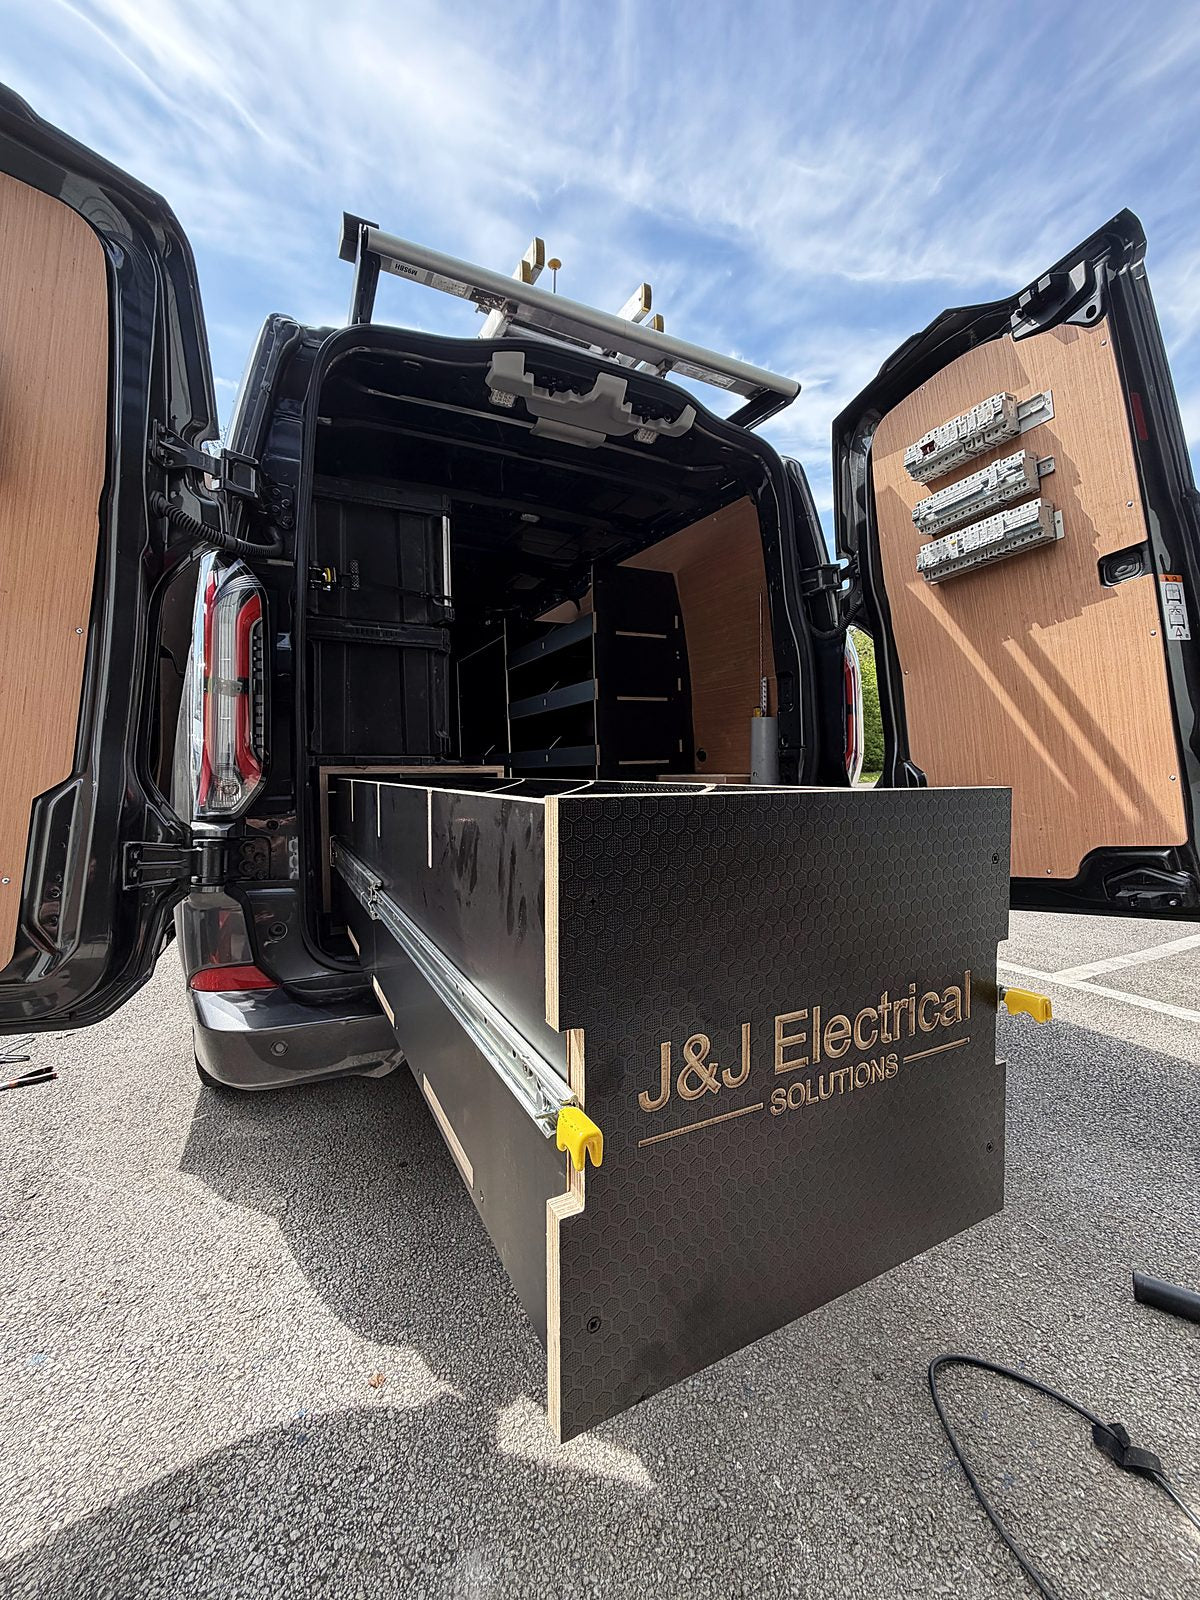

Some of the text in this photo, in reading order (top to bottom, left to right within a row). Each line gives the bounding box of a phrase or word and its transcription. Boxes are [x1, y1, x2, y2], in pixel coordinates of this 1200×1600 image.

[638, 970, 972, 1112] J&J Electrical
[770, 1053, 899, 1116] SOLUTIONS
